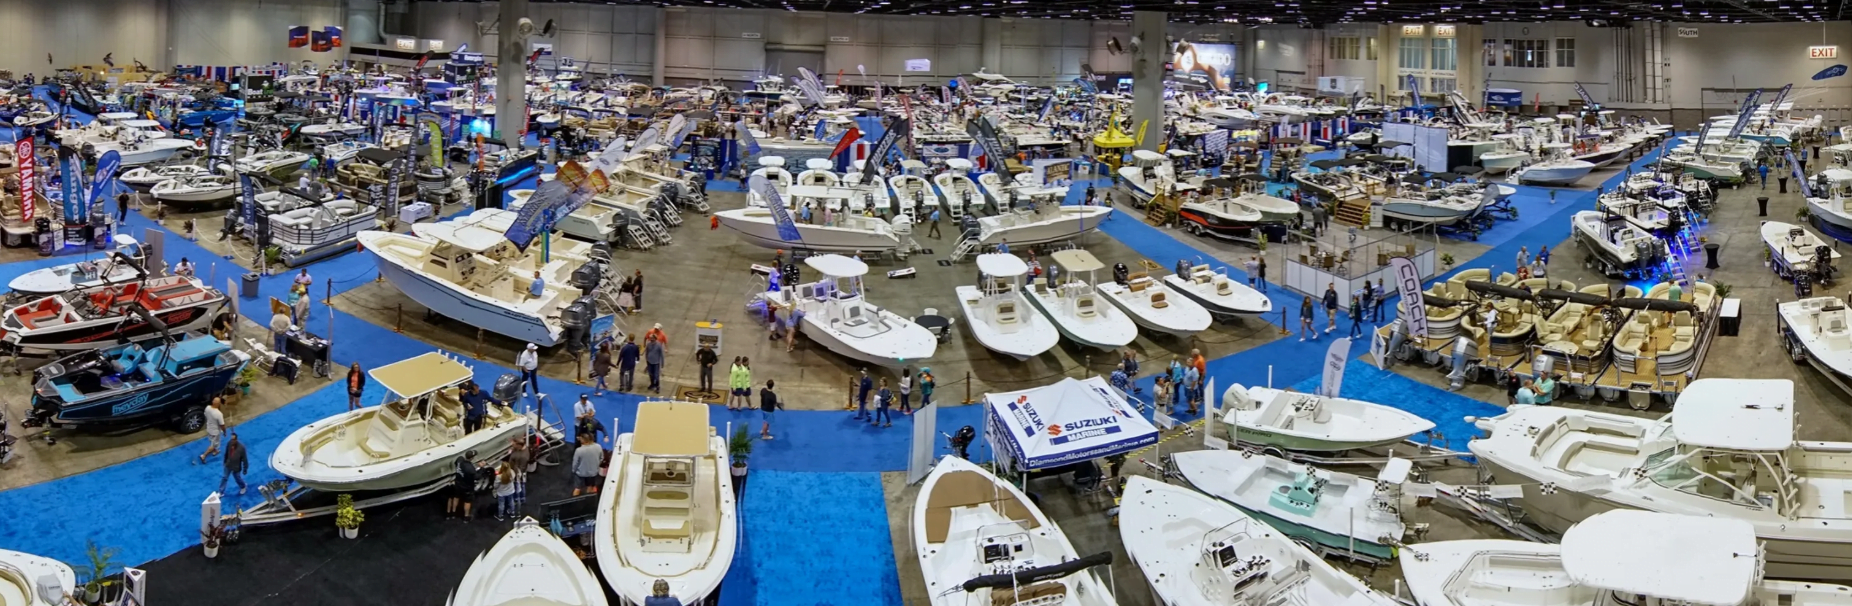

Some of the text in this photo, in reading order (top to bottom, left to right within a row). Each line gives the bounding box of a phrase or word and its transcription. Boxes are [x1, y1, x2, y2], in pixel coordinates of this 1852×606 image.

[1405, 26, 1421, 35] EXIT
[1437, 26, 1454, 36] EXIT
[1811, 47, 1835, 58] EXIT
[20, 157, 32, 220] YAMAHA
[1401, 263, 1425, 333] COACH
[111, 392, 148, 415] heyday
[1023, 402, 1046, 431] SUZUKI
